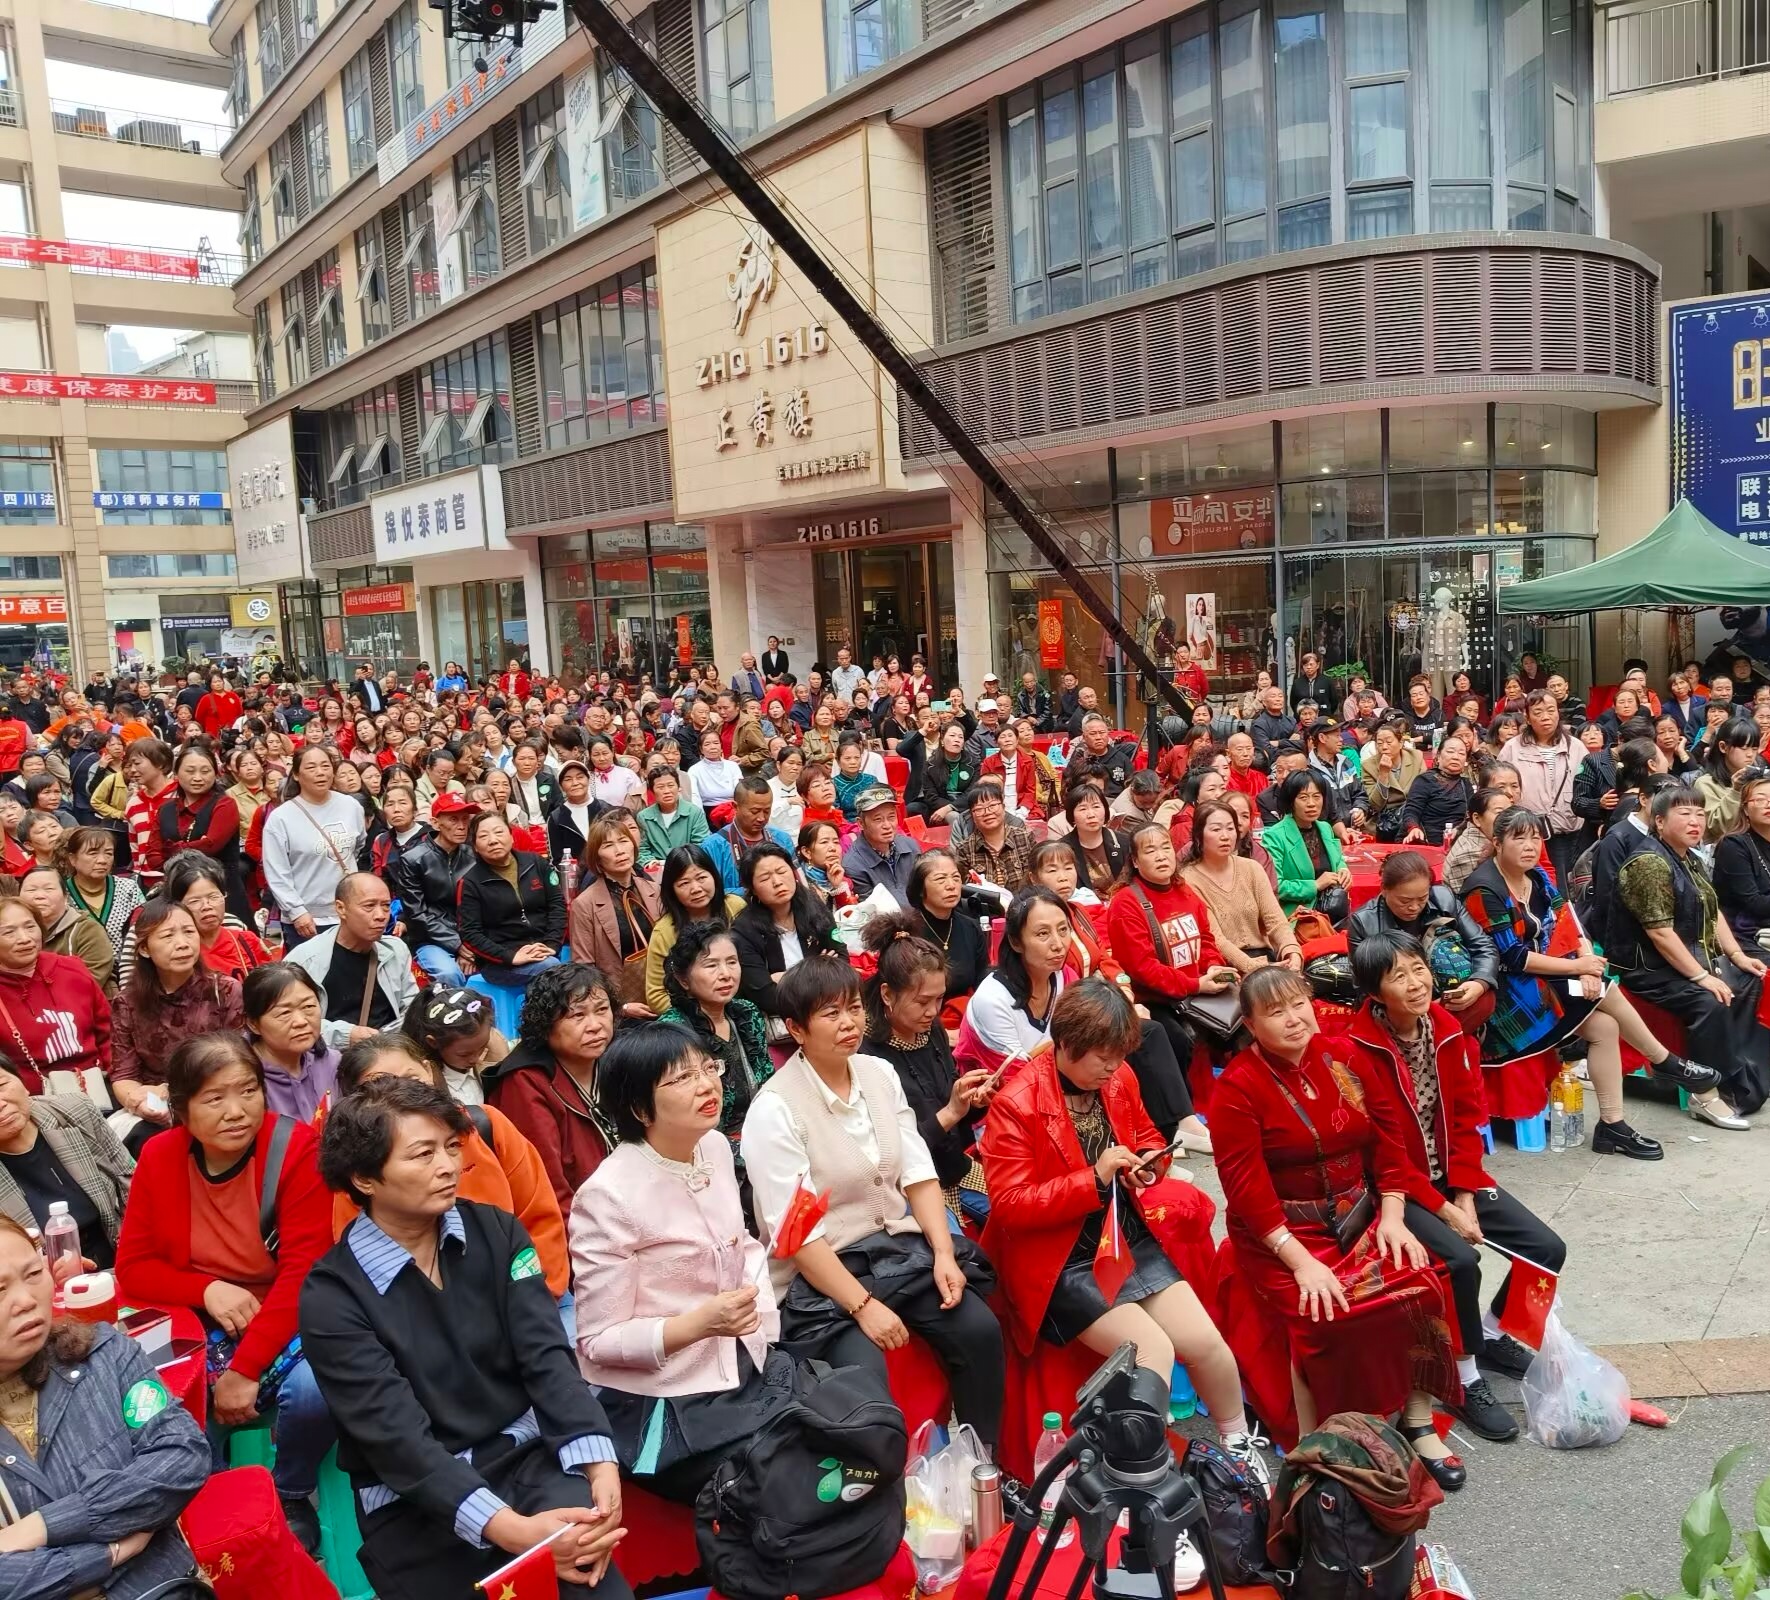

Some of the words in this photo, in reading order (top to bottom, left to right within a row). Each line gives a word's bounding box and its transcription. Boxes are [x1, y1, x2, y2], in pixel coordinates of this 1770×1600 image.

[695, 346, 750, 387] ZHQ
[760, 322, 828, 369] 1616
[1741, 478, 1770, 497] 联
[93, 494, 200, 506] 都)律师事务所
[1741, 501, 1770, 519] 电
[385, 493, 465, 543] 锦悦泰商管
[797, 524, 833, 543] ZHQ
[840, 517, 878, 539] 1616
